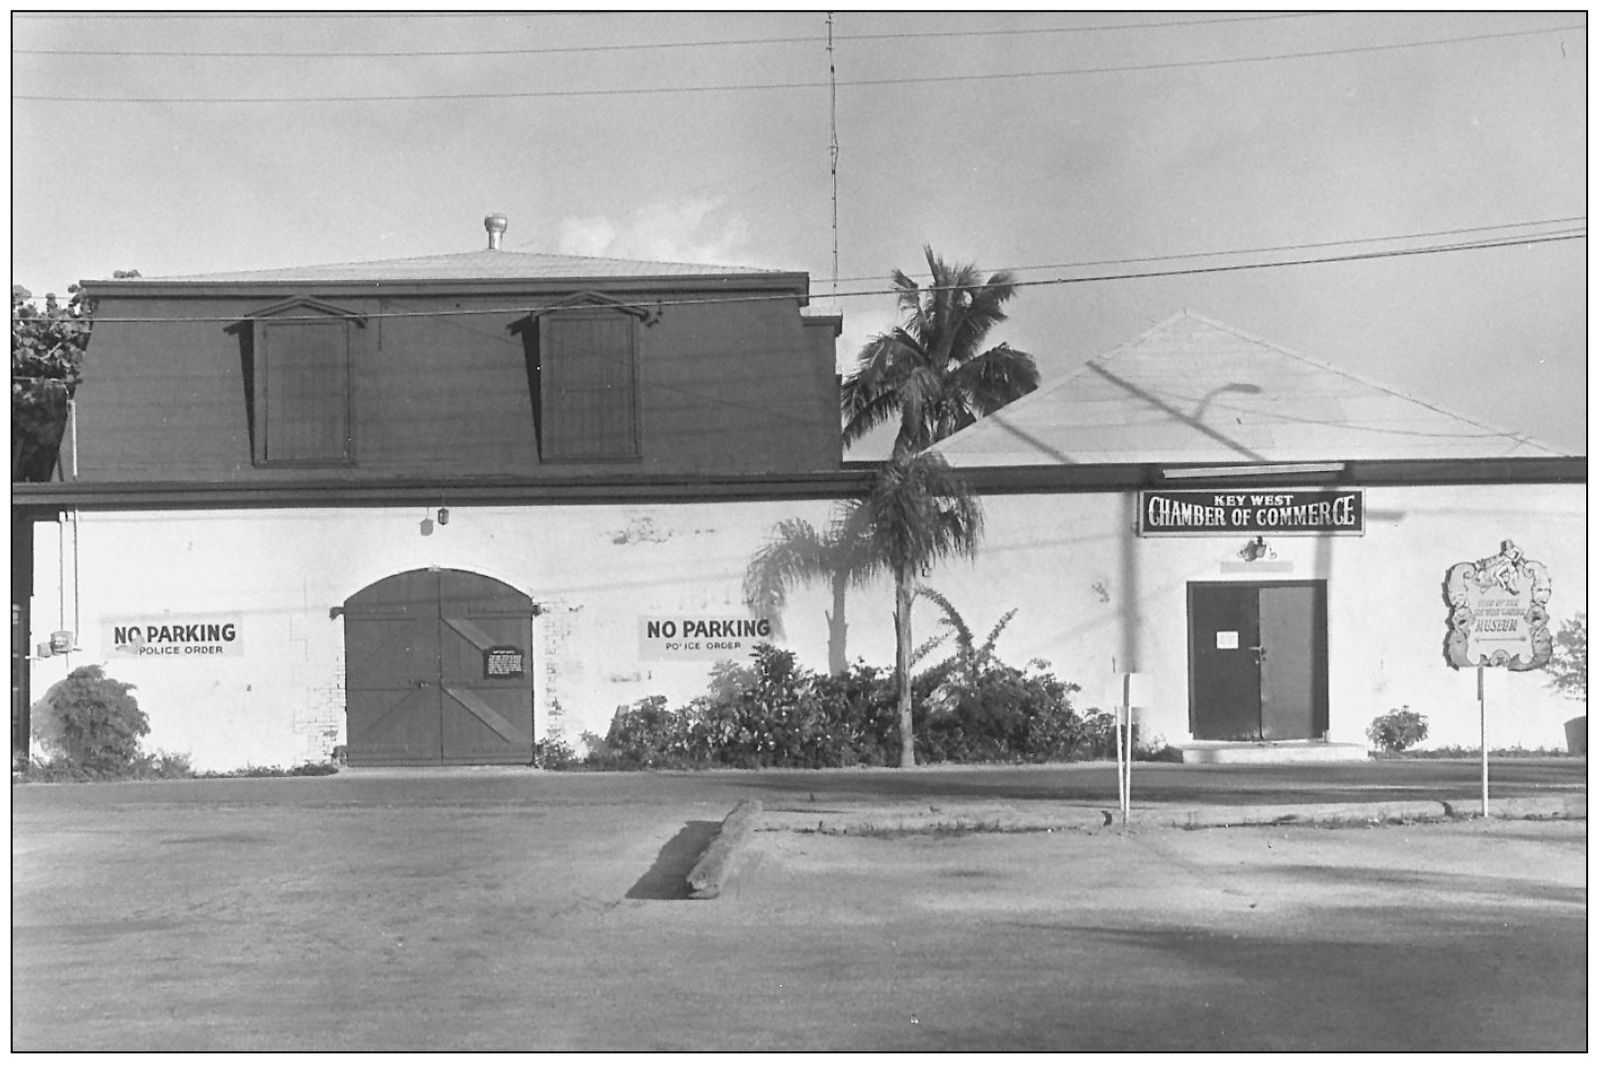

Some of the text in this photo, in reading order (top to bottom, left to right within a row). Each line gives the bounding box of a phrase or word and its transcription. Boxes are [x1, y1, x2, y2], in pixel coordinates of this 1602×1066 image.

[1214, 495, 1294, 506] KEY WEST
[1149, 495, 1355, 526] CHAMBER OF COMMERCE
[647, 619, 771, 638] NO PARKING
[1475, 619, 1518, 632] MUSEUM
[114, 623, 236, 644] NO PARKING
[139, 645, 223, 655] POLICE ORDER
[666, 642, 741, 651] POICE ORDER
